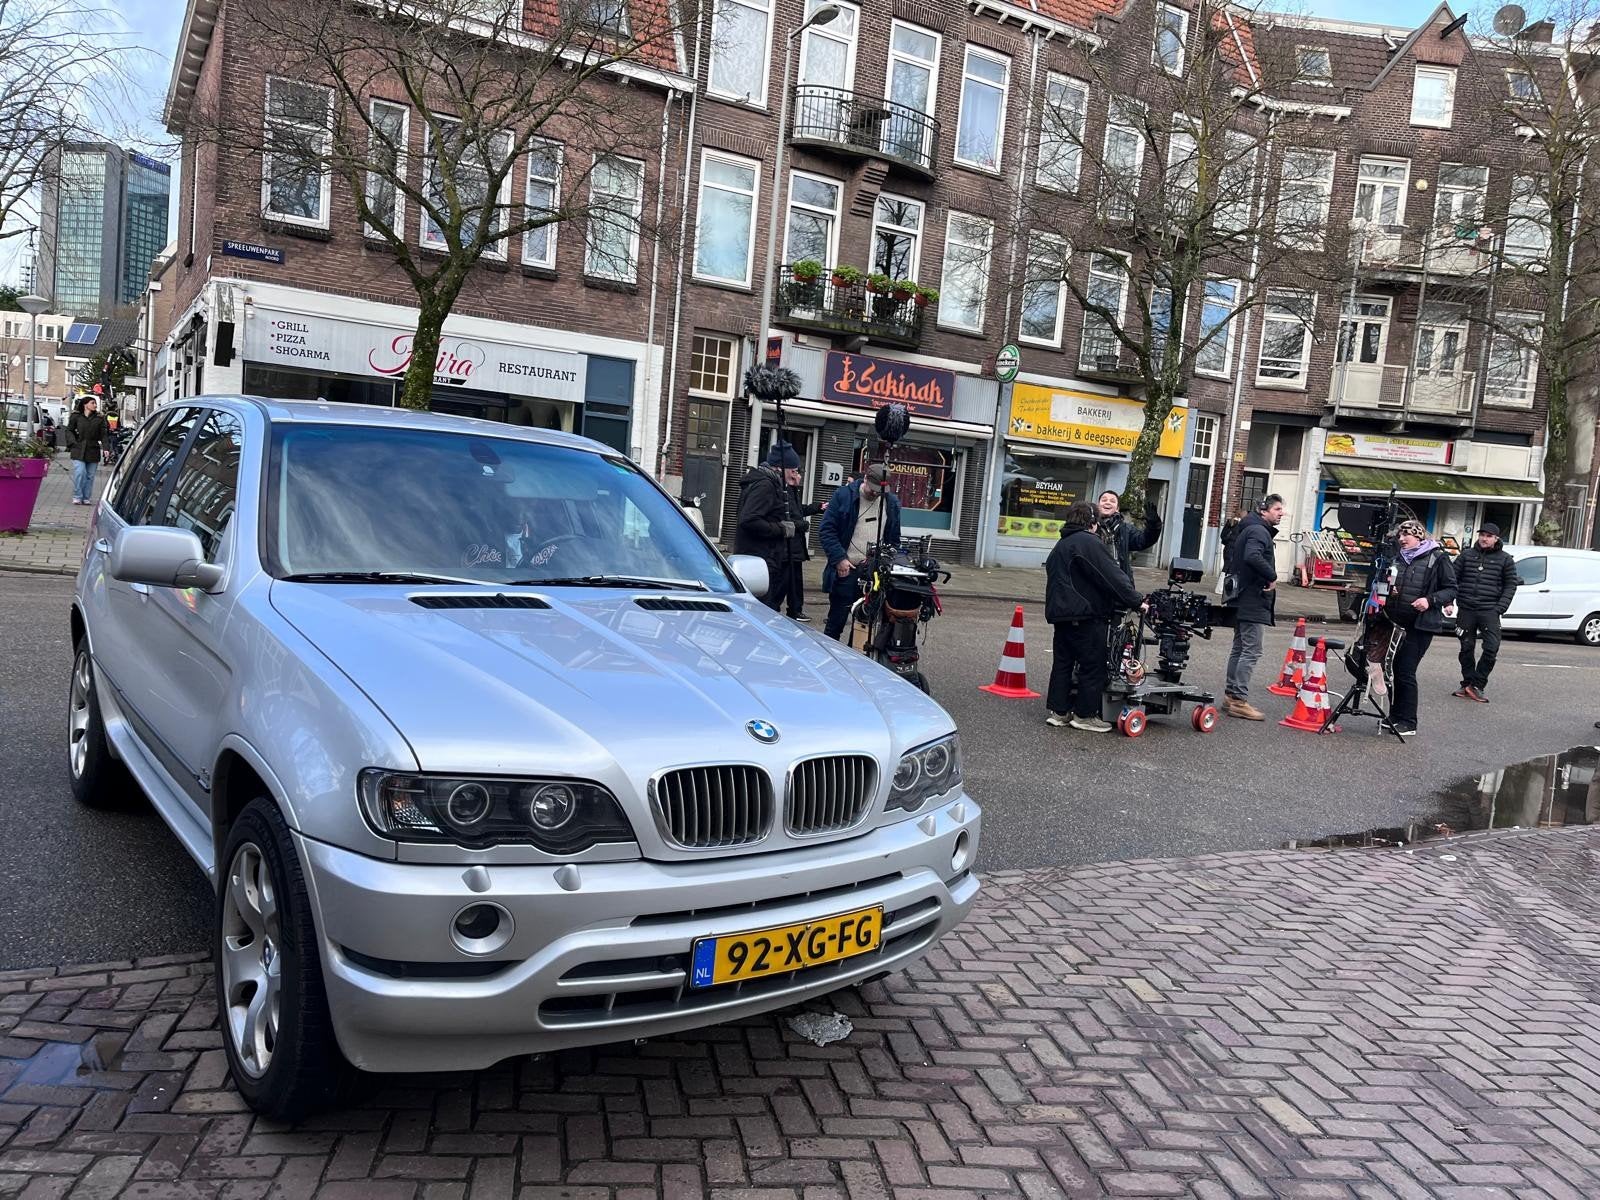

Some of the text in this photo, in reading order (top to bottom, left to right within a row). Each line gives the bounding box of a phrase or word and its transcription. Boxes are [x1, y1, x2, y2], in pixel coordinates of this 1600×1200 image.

[228, 242, 279, 257] SPREEUWENPARK
[277, 320, 309, 333] GRILL
[276, 333, 306, 345] PIZZA
[275, 345, 330, 361] SHOARMA
[498, 362, 577, 382] RESTAURANT
[856, 361, 945, 404] Sakinah
[1077, 406, 1113, 420] BAKKERIJ
[1036, 423, 1139, 448] bakkerij & deegspeciali
[1035, 481, 1063, 491] BEYHAN
[727, 915, 873, 976] 92-XG-FG
[695, 966, 711, 979] NL
